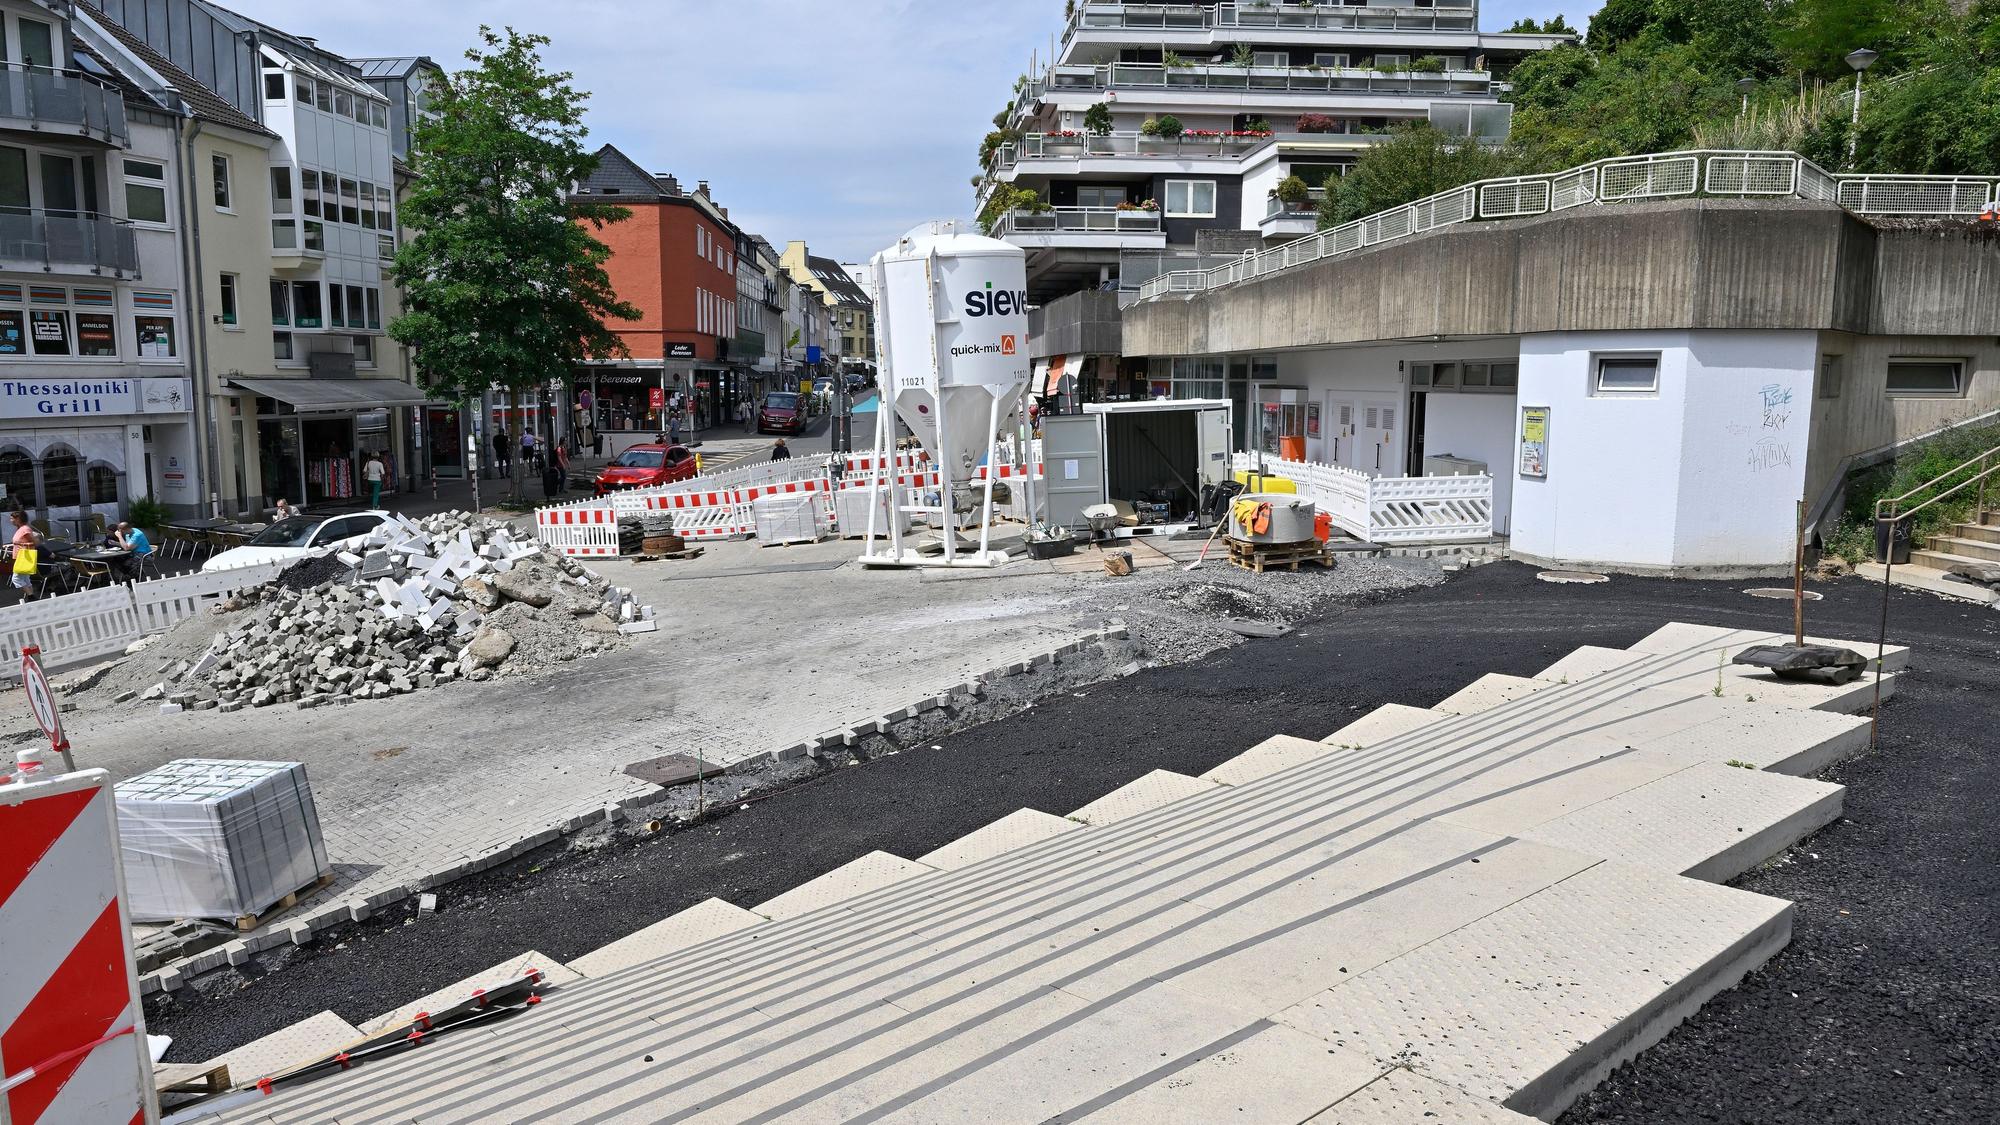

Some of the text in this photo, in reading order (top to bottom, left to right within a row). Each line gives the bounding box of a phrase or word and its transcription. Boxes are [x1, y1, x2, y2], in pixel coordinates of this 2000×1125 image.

[33, 321, 61, 334] 123
[950, 343, 1000, 357] quick-mix
[600, 374, 642, 384] Berensen
[901, 376, 925, 386] 11021
[3, 381, 129, 396] Thessaloniki
[37, 399, 101, 413] Grill
